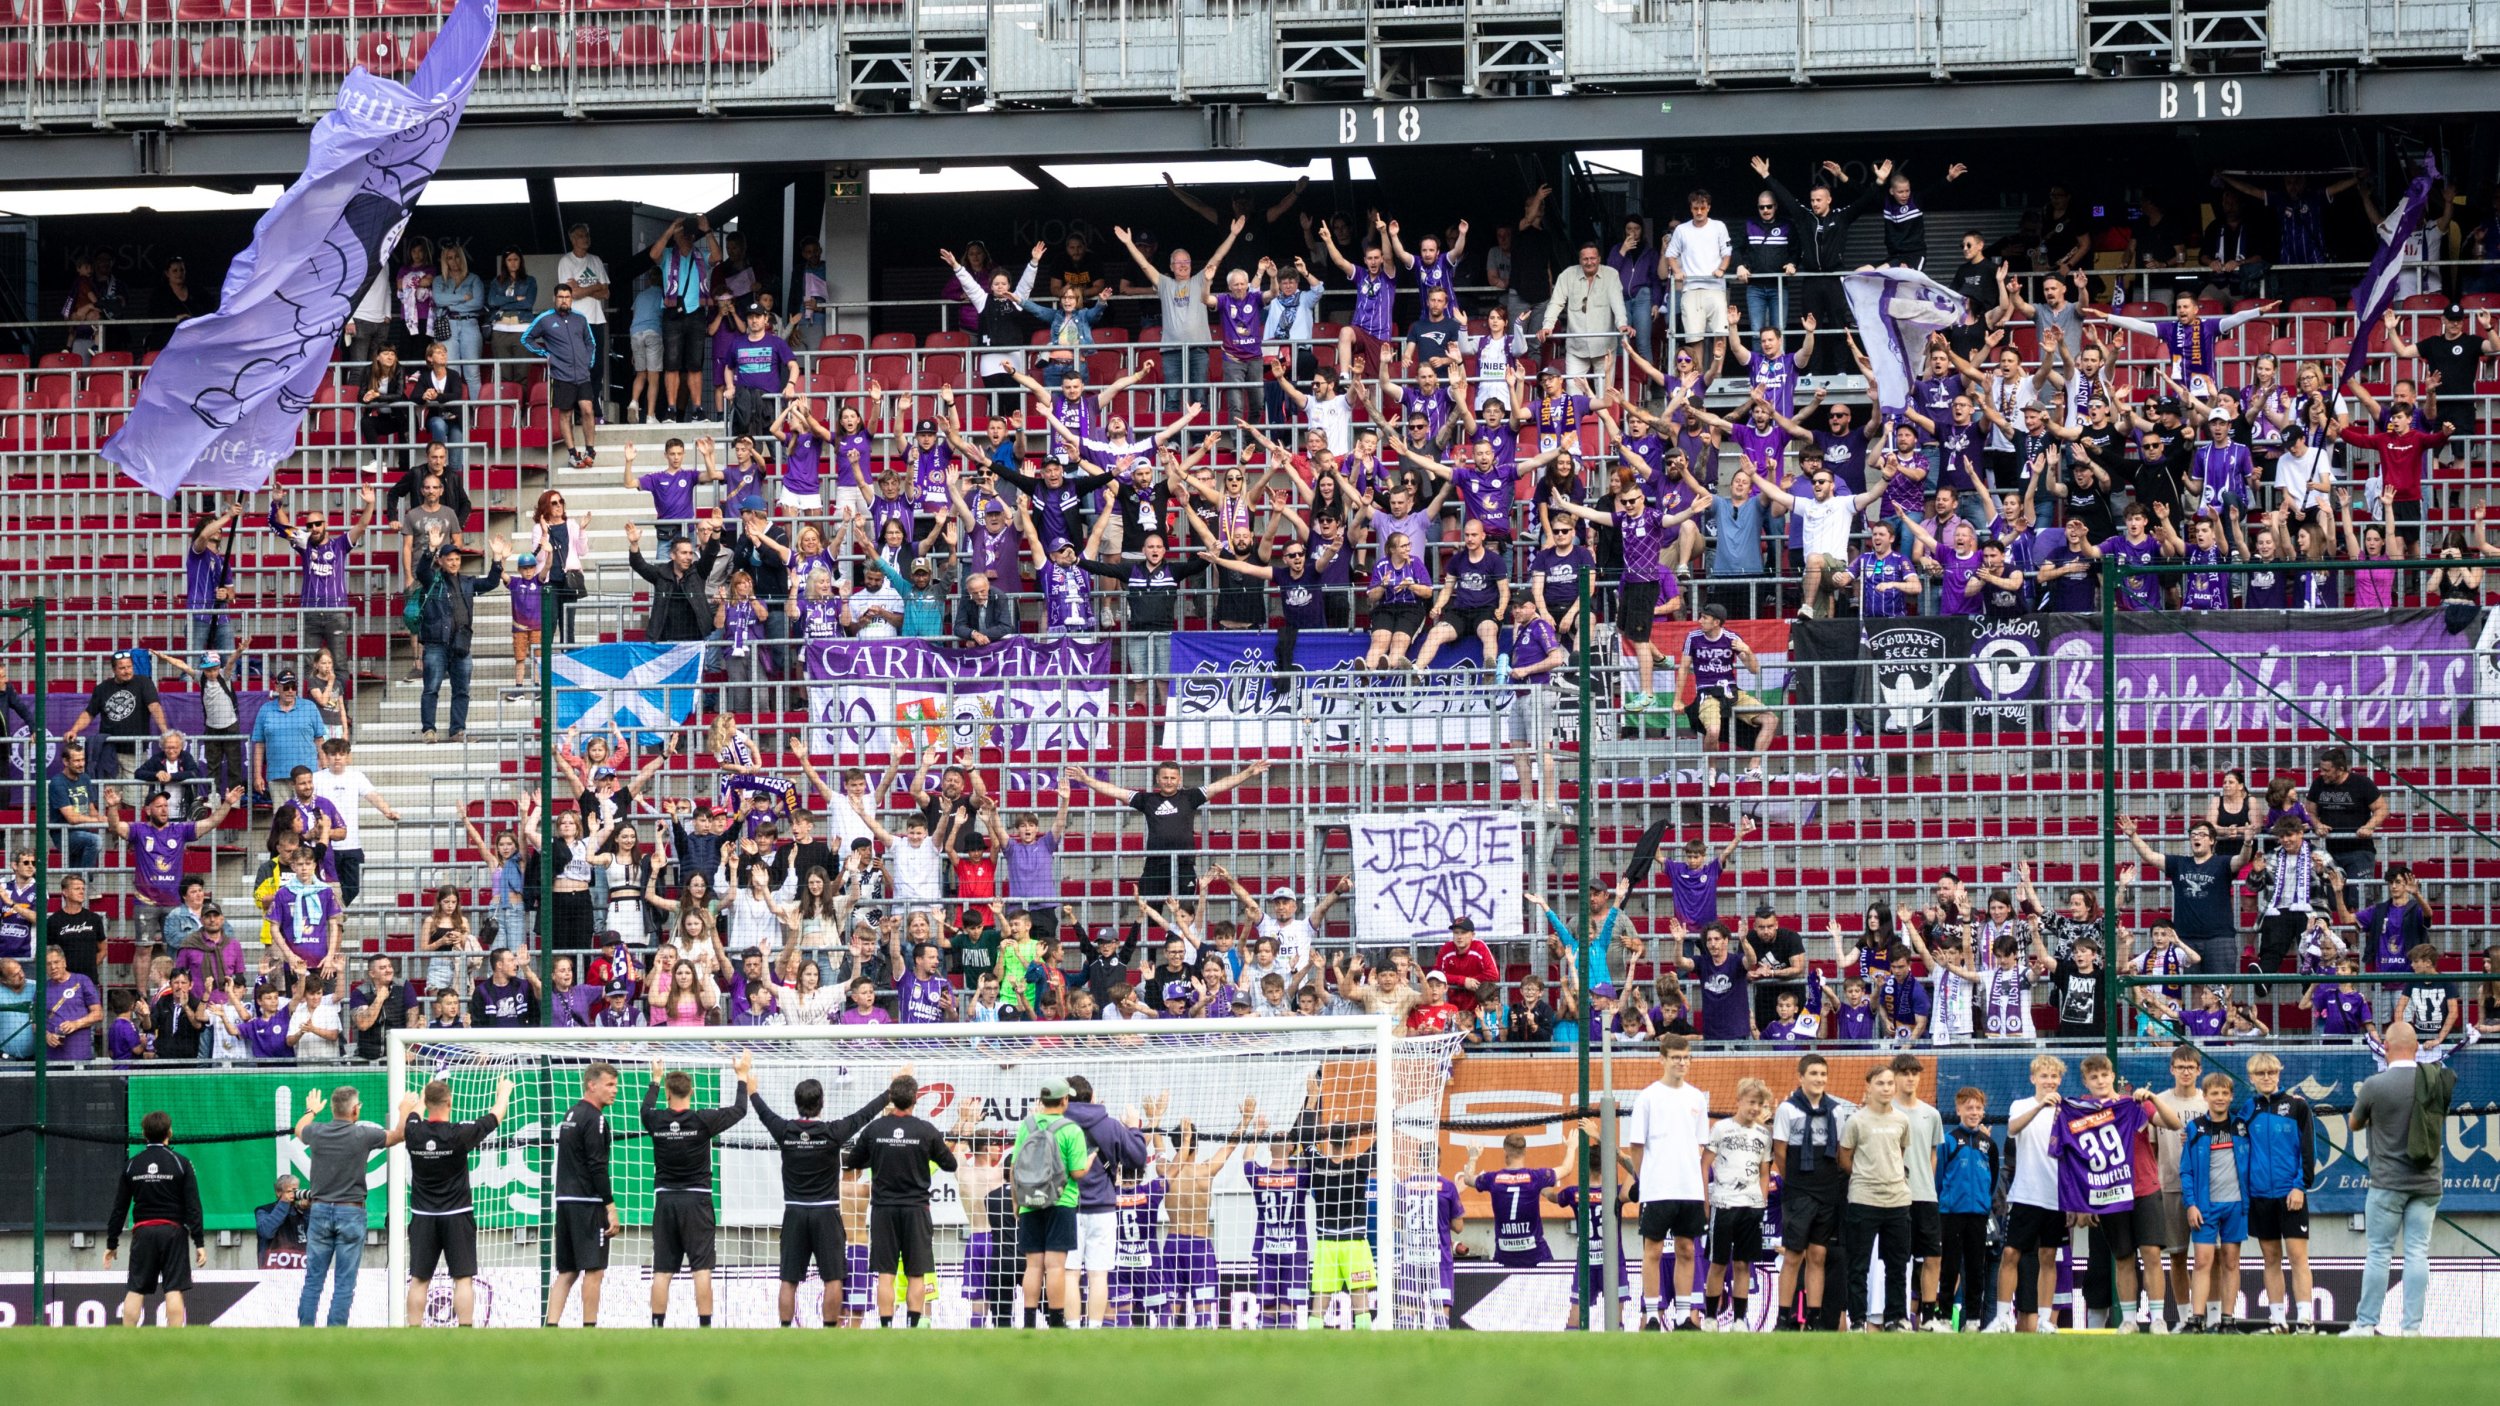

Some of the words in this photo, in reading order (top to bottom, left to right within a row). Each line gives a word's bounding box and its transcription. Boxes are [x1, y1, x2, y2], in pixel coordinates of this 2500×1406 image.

[821, 644, 1095, 682] CARINTHIAN
[1696, 648, 1732, 659] HYPO
[1697, 663, 1733, 673] AUSTRIA
[821, 696, 876, 748] 90
[1361, 815, 1518, 874] JEBOTE
[2078, 1122, 2125, 1174] 39
[2338, 1174, 2371, 1189] Ech
[2443, 1174, 2500, 1193] nschaf
[1261, 1191, 1294, 1225] 37
[1506, 1187, 1521, 1221] 7
[1121, 1209, 1141, 1242] 6
[1500, 1221, 1531, 1235] JARITZ
[1503, 1238, 1532, 1247] UNIBET
